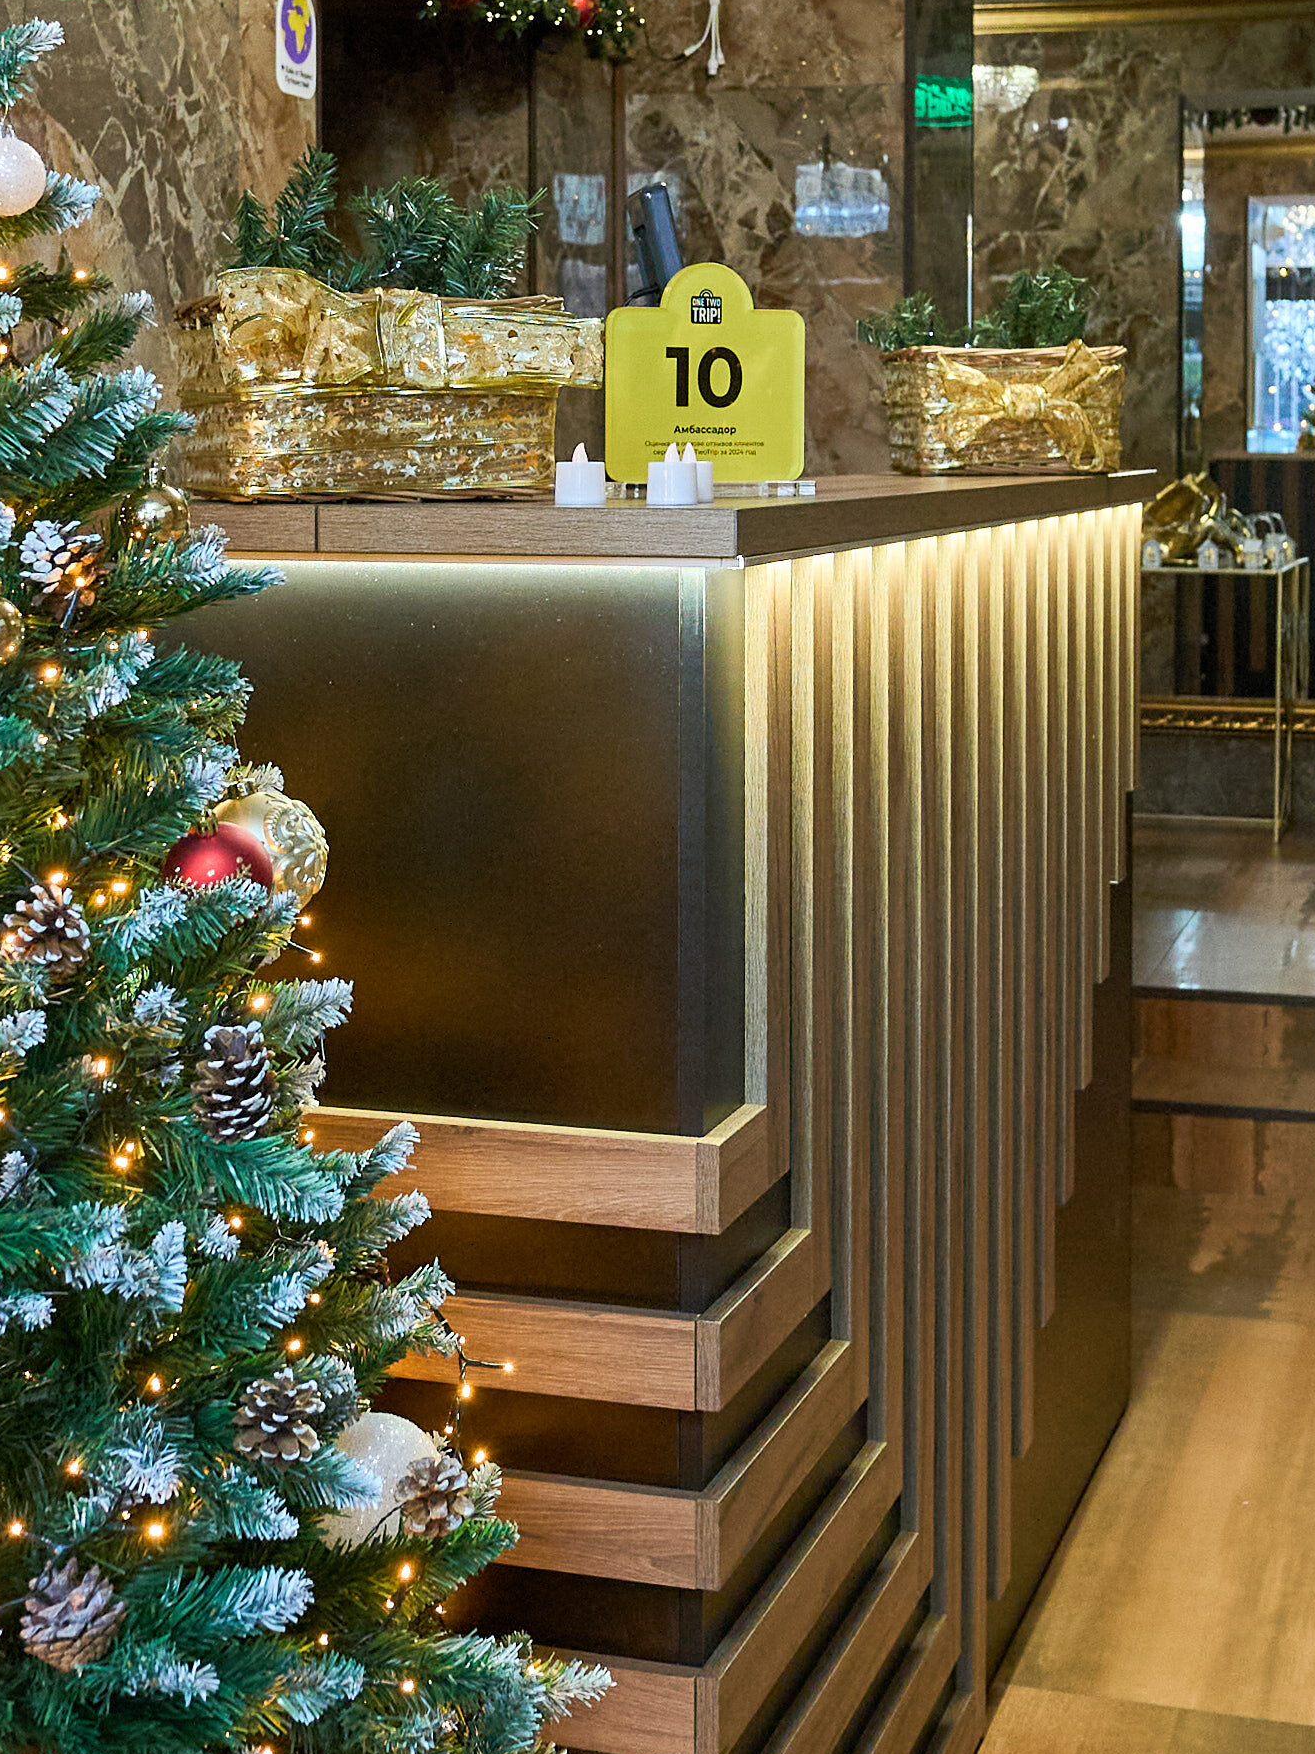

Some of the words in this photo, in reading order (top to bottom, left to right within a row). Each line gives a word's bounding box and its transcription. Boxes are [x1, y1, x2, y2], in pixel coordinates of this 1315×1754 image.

[692, 298, 704, 307] ONE
[706, 298, 721, 307] TWO
[692, 307, 721, 323] TRIP!
[666, 346, 743, 408] 10
[674, 425, 737, 436] Амбассадор
